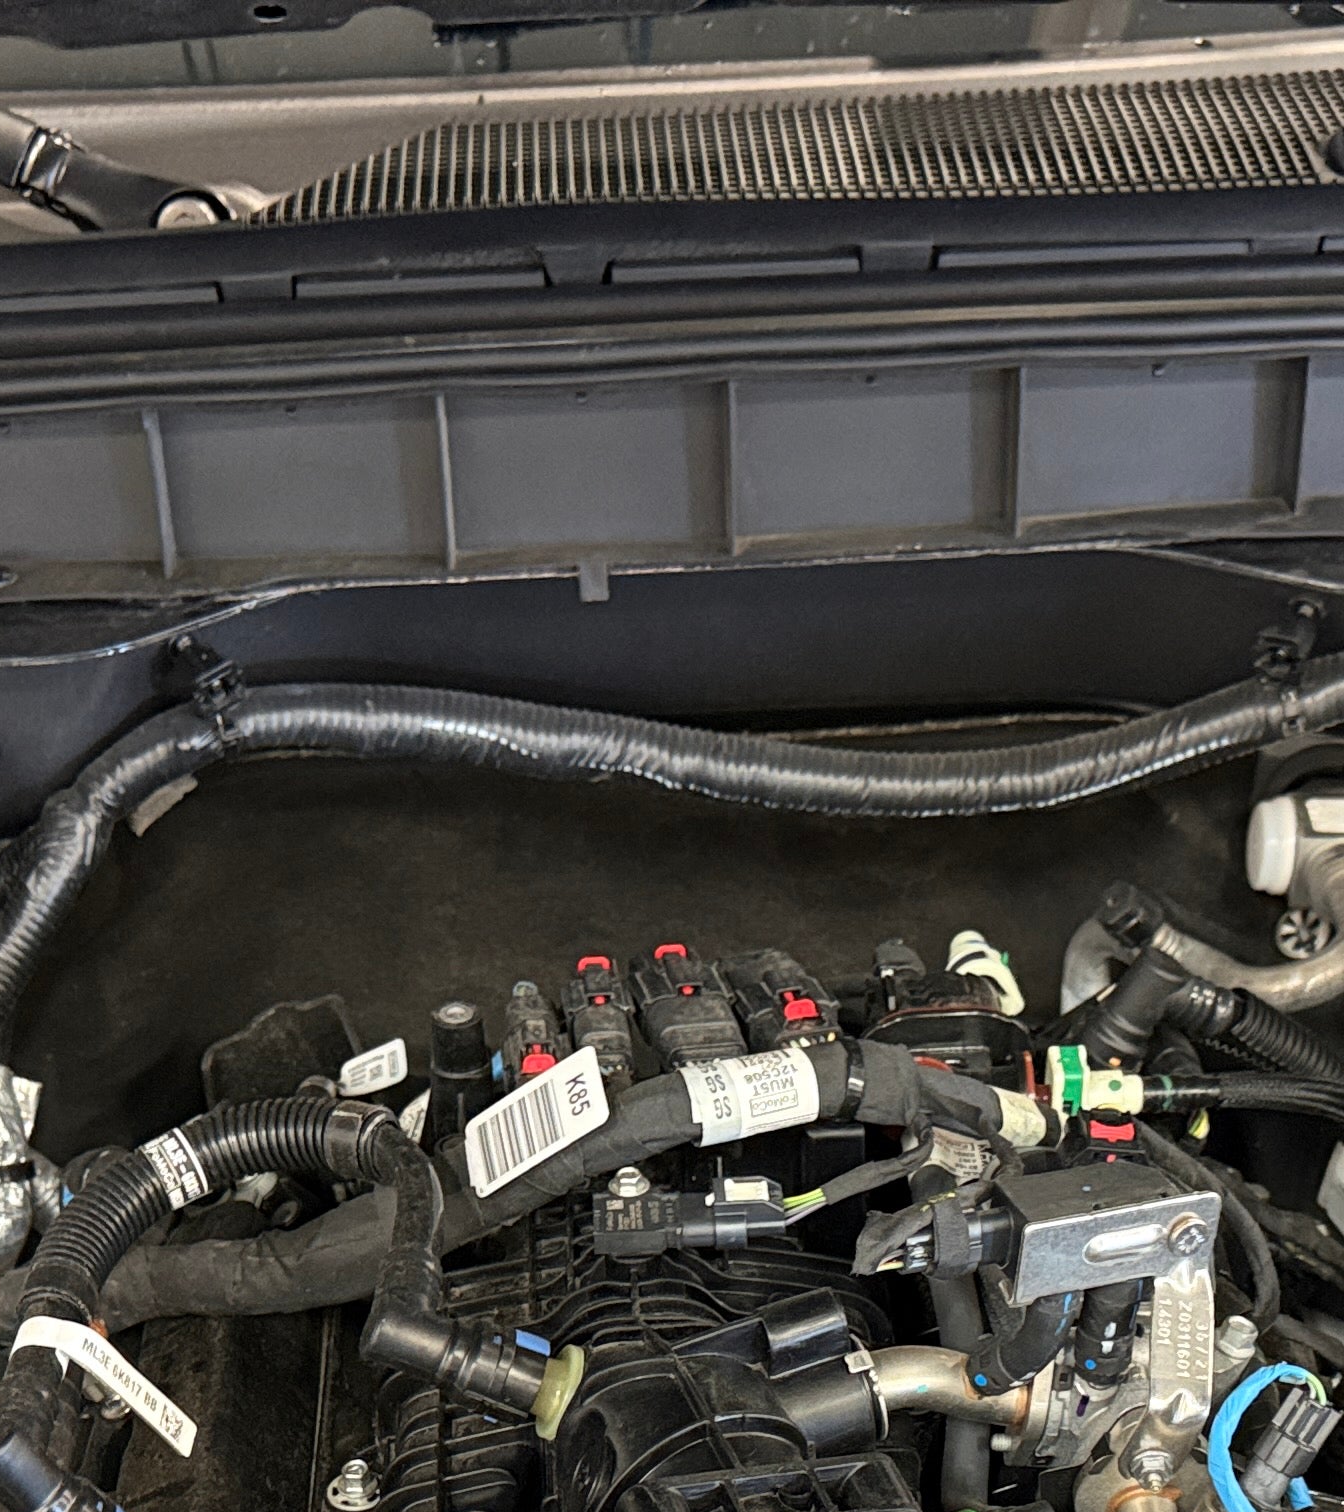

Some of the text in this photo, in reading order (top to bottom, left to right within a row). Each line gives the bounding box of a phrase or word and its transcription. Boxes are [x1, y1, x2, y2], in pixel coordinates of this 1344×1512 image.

[565, 1072, 591, 1117] K85
[704, 1074, 726, 1094] SG
[713, 1096, 732, 1120] SG
[1156, 1298, 1173, 1346] 1.4301
[1176, 1300, 1194, 1378] 20311601
[81, 1338, 112, 1370] ML3E
[112, 1364, 143, 1397] 6K817
